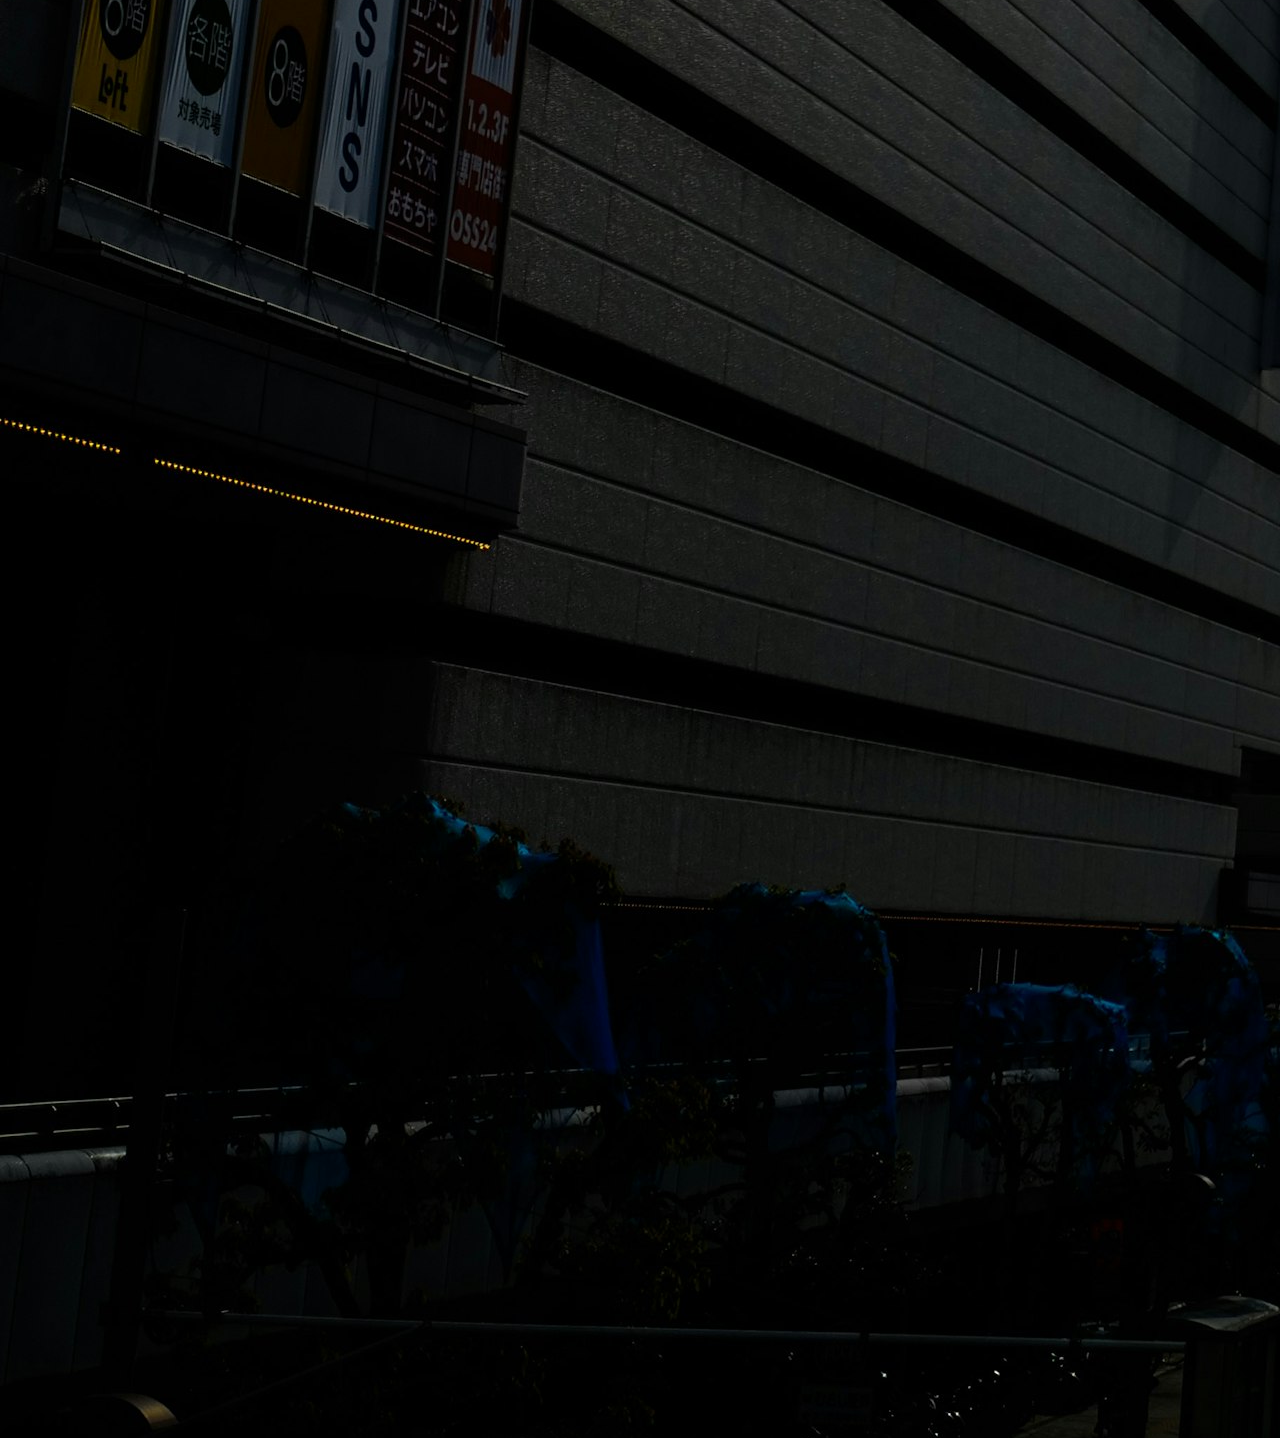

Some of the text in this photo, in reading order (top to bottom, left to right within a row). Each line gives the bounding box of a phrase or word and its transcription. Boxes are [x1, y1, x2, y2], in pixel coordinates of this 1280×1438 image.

[187, 15, 232, 71] 各階
[412, 39, 451, 86] テレビ
[269, 38, 306, 108] 8階
[176, 96, 223, 137] 対象売場
[400, 86, 450, 134] パソコン
[398, 138, 439, 184] スマホ
[455, 150, 507, 203] 専門店街
[387, 188, 439, 234] おもちゃ
[449, 207, 497, 252] OSS24
